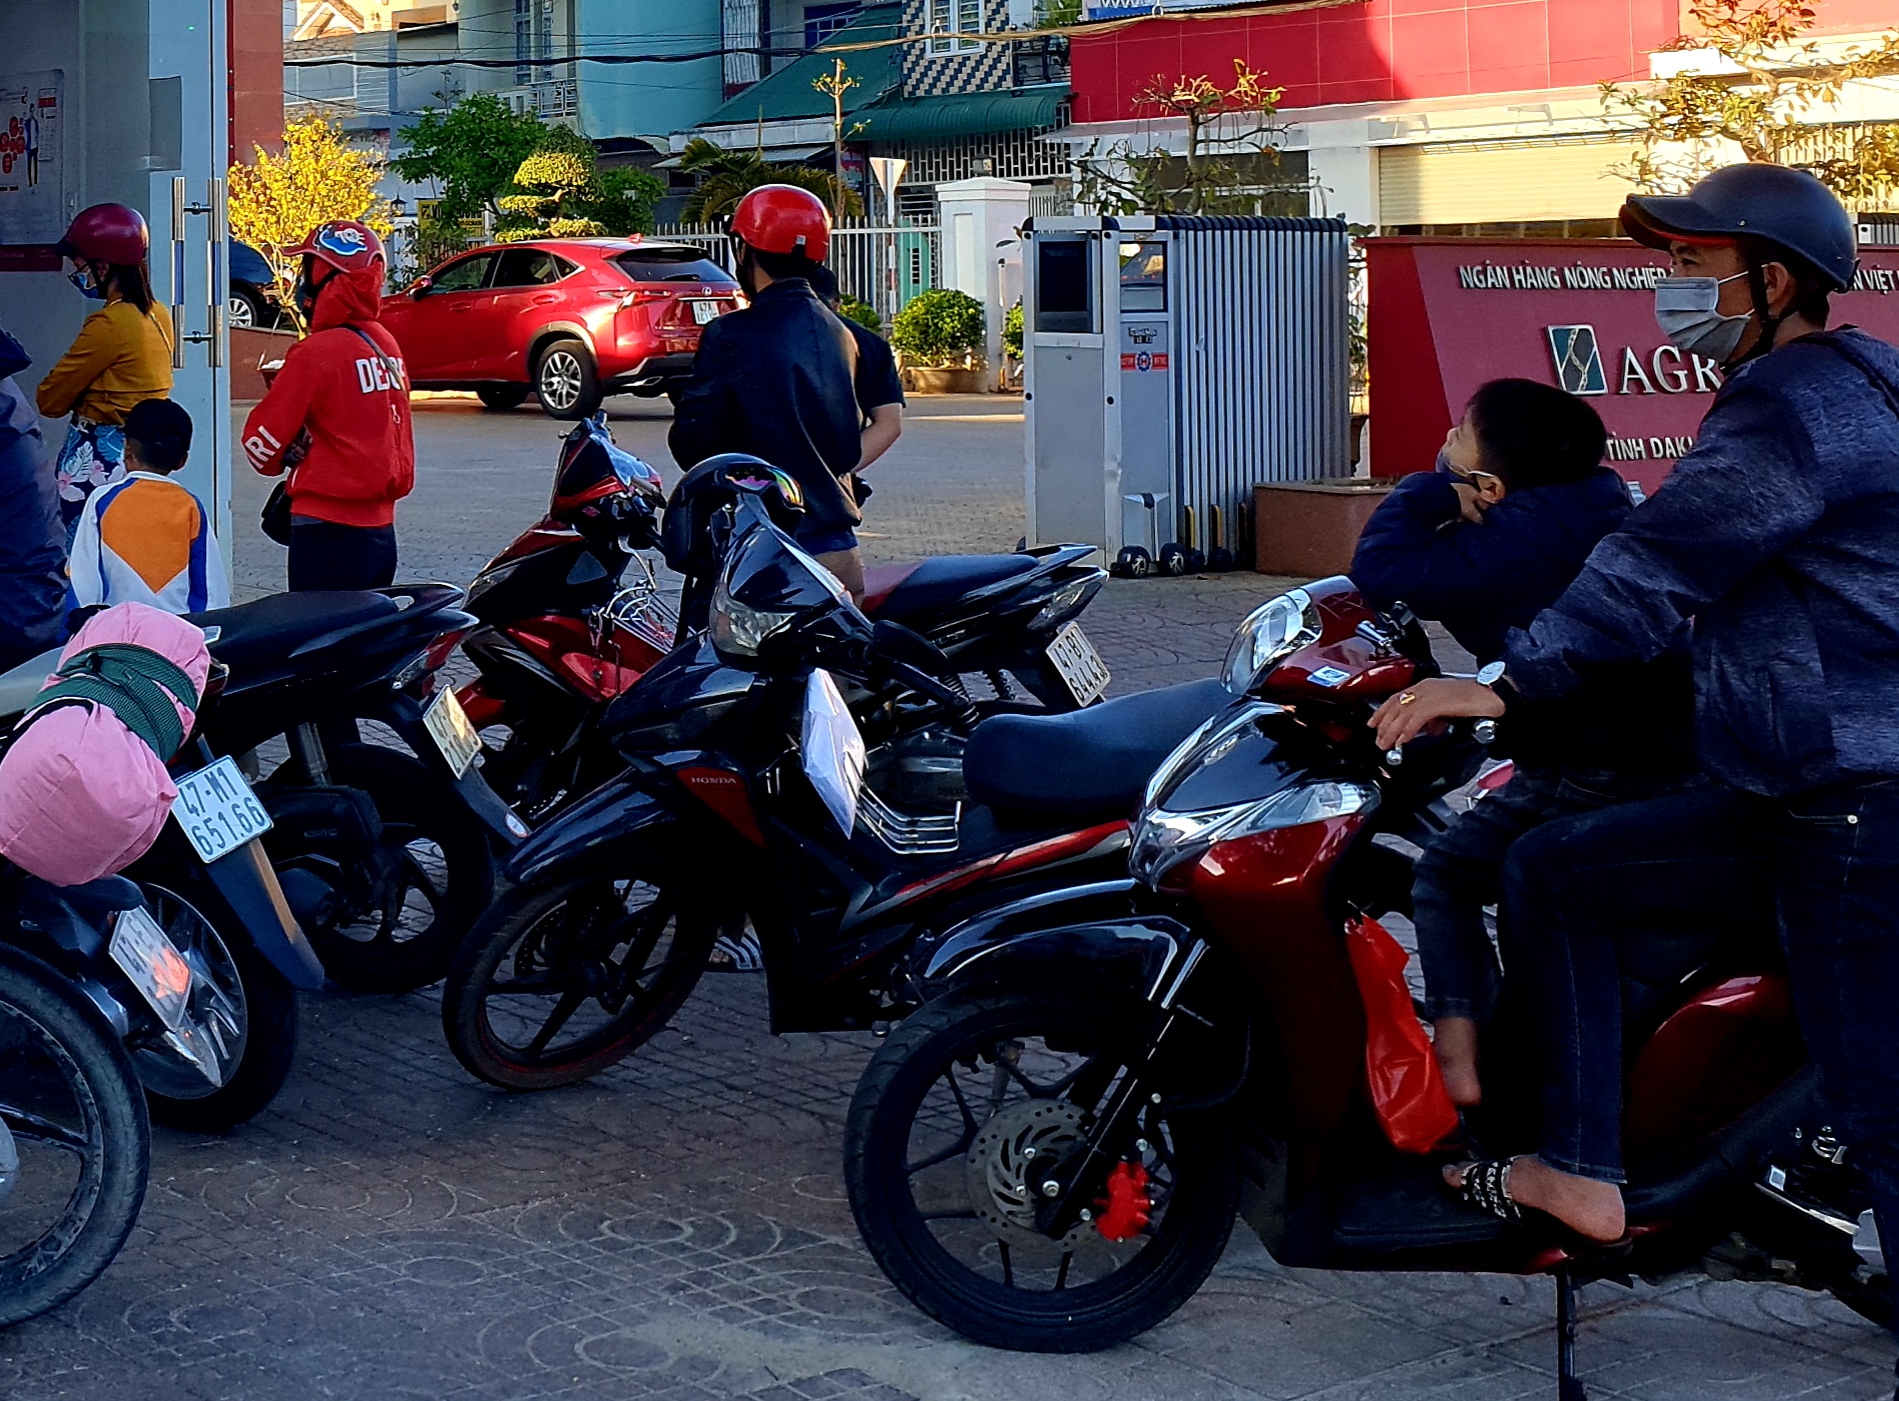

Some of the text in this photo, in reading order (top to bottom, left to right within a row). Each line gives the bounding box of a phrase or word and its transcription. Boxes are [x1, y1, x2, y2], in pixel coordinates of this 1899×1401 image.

[1459, 259, 1511, 289] NGÂN
[1512, 259, 1561, 289] HÀNG
[1563, 260, 1613, 290] NÔNG
[1863, 264, 1897, 295] VIỆT
[1619, 345, 1723, 394] AGR
[178, 766, 238, 817] 47-M1
[191, 796, 266, 856] 651.66
